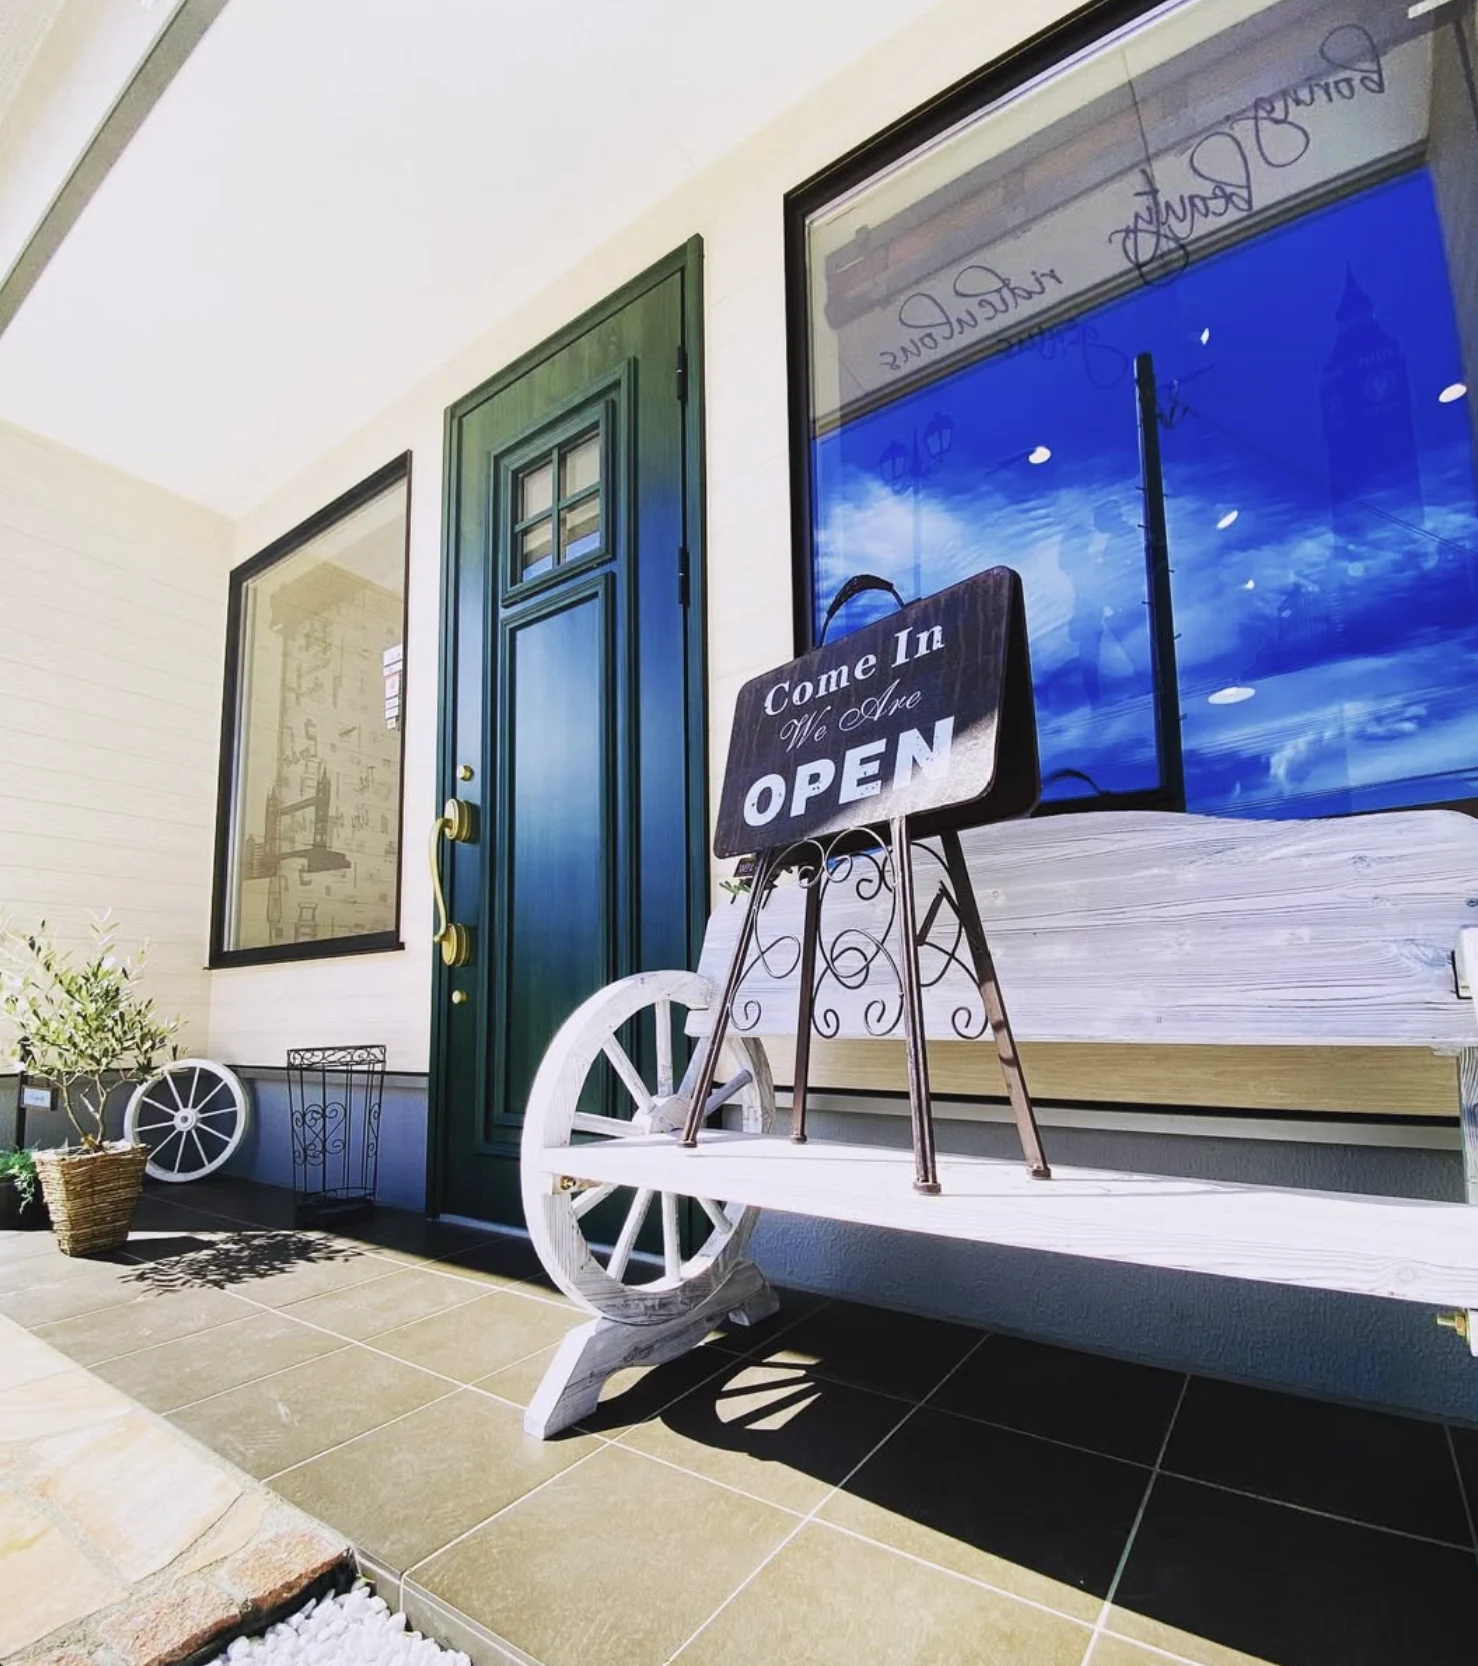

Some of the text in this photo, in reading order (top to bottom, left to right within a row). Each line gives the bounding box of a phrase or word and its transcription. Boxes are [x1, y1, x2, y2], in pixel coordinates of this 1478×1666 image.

[763, 623, 944, 717] Come In
[780, 678, 922, 753] We Are
[743, 716, 955, 827] OPEN
